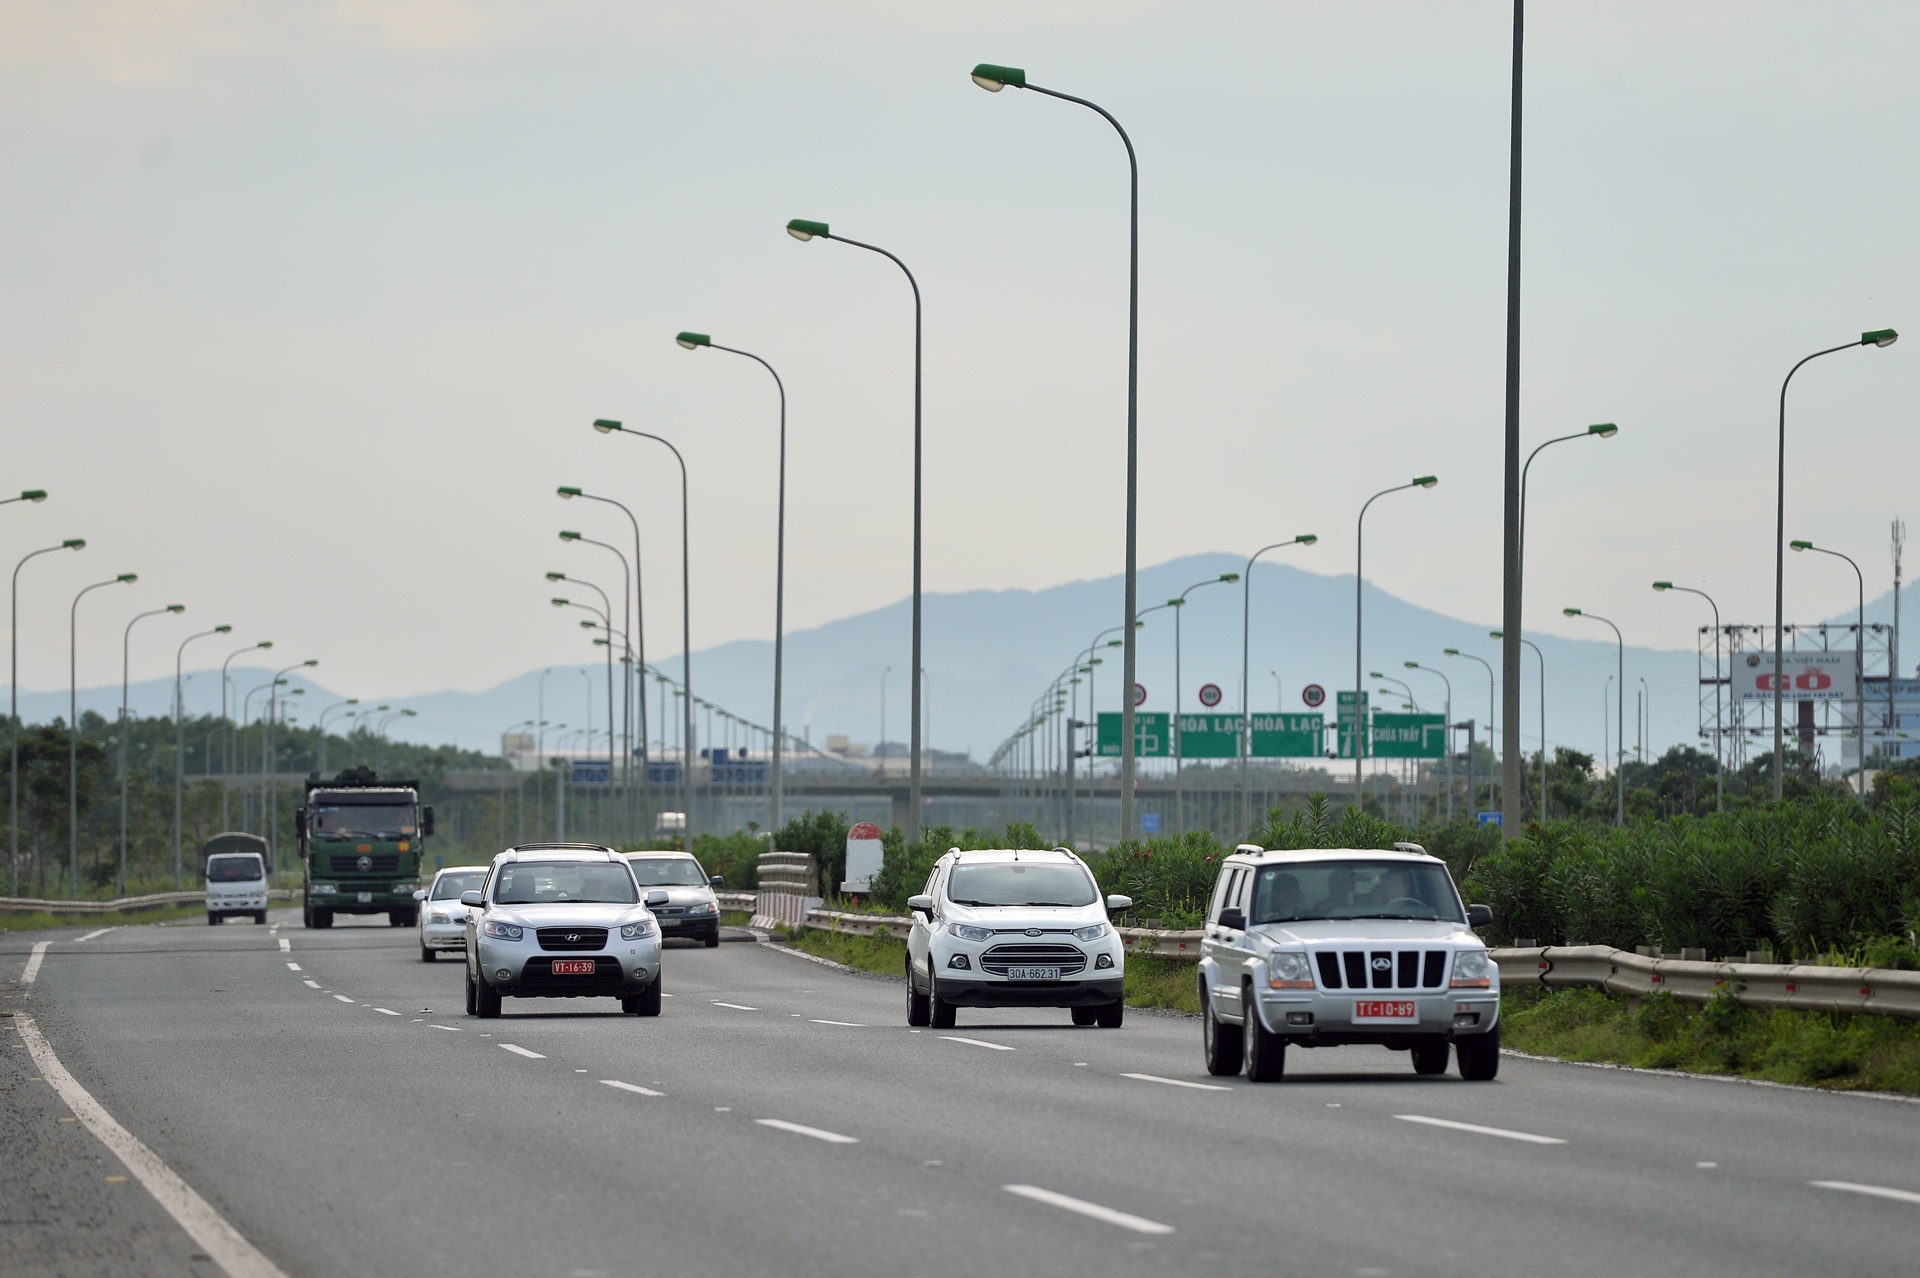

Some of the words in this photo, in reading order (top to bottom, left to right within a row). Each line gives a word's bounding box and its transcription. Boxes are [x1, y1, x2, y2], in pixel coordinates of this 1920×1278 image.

[1816, 656, 1841, 665] NAM
[1214, 717, 1244, 735] LẠC
[1253, 714, 1285, 732] HÒA
[1290, 717, 1321, 735] LẠC
[554, 962, 593, 973] VT-16-39
[1009, 968, 1059, 979] 30A-662.31
[1358, 1002, 1414, 1016] TT-10-89
